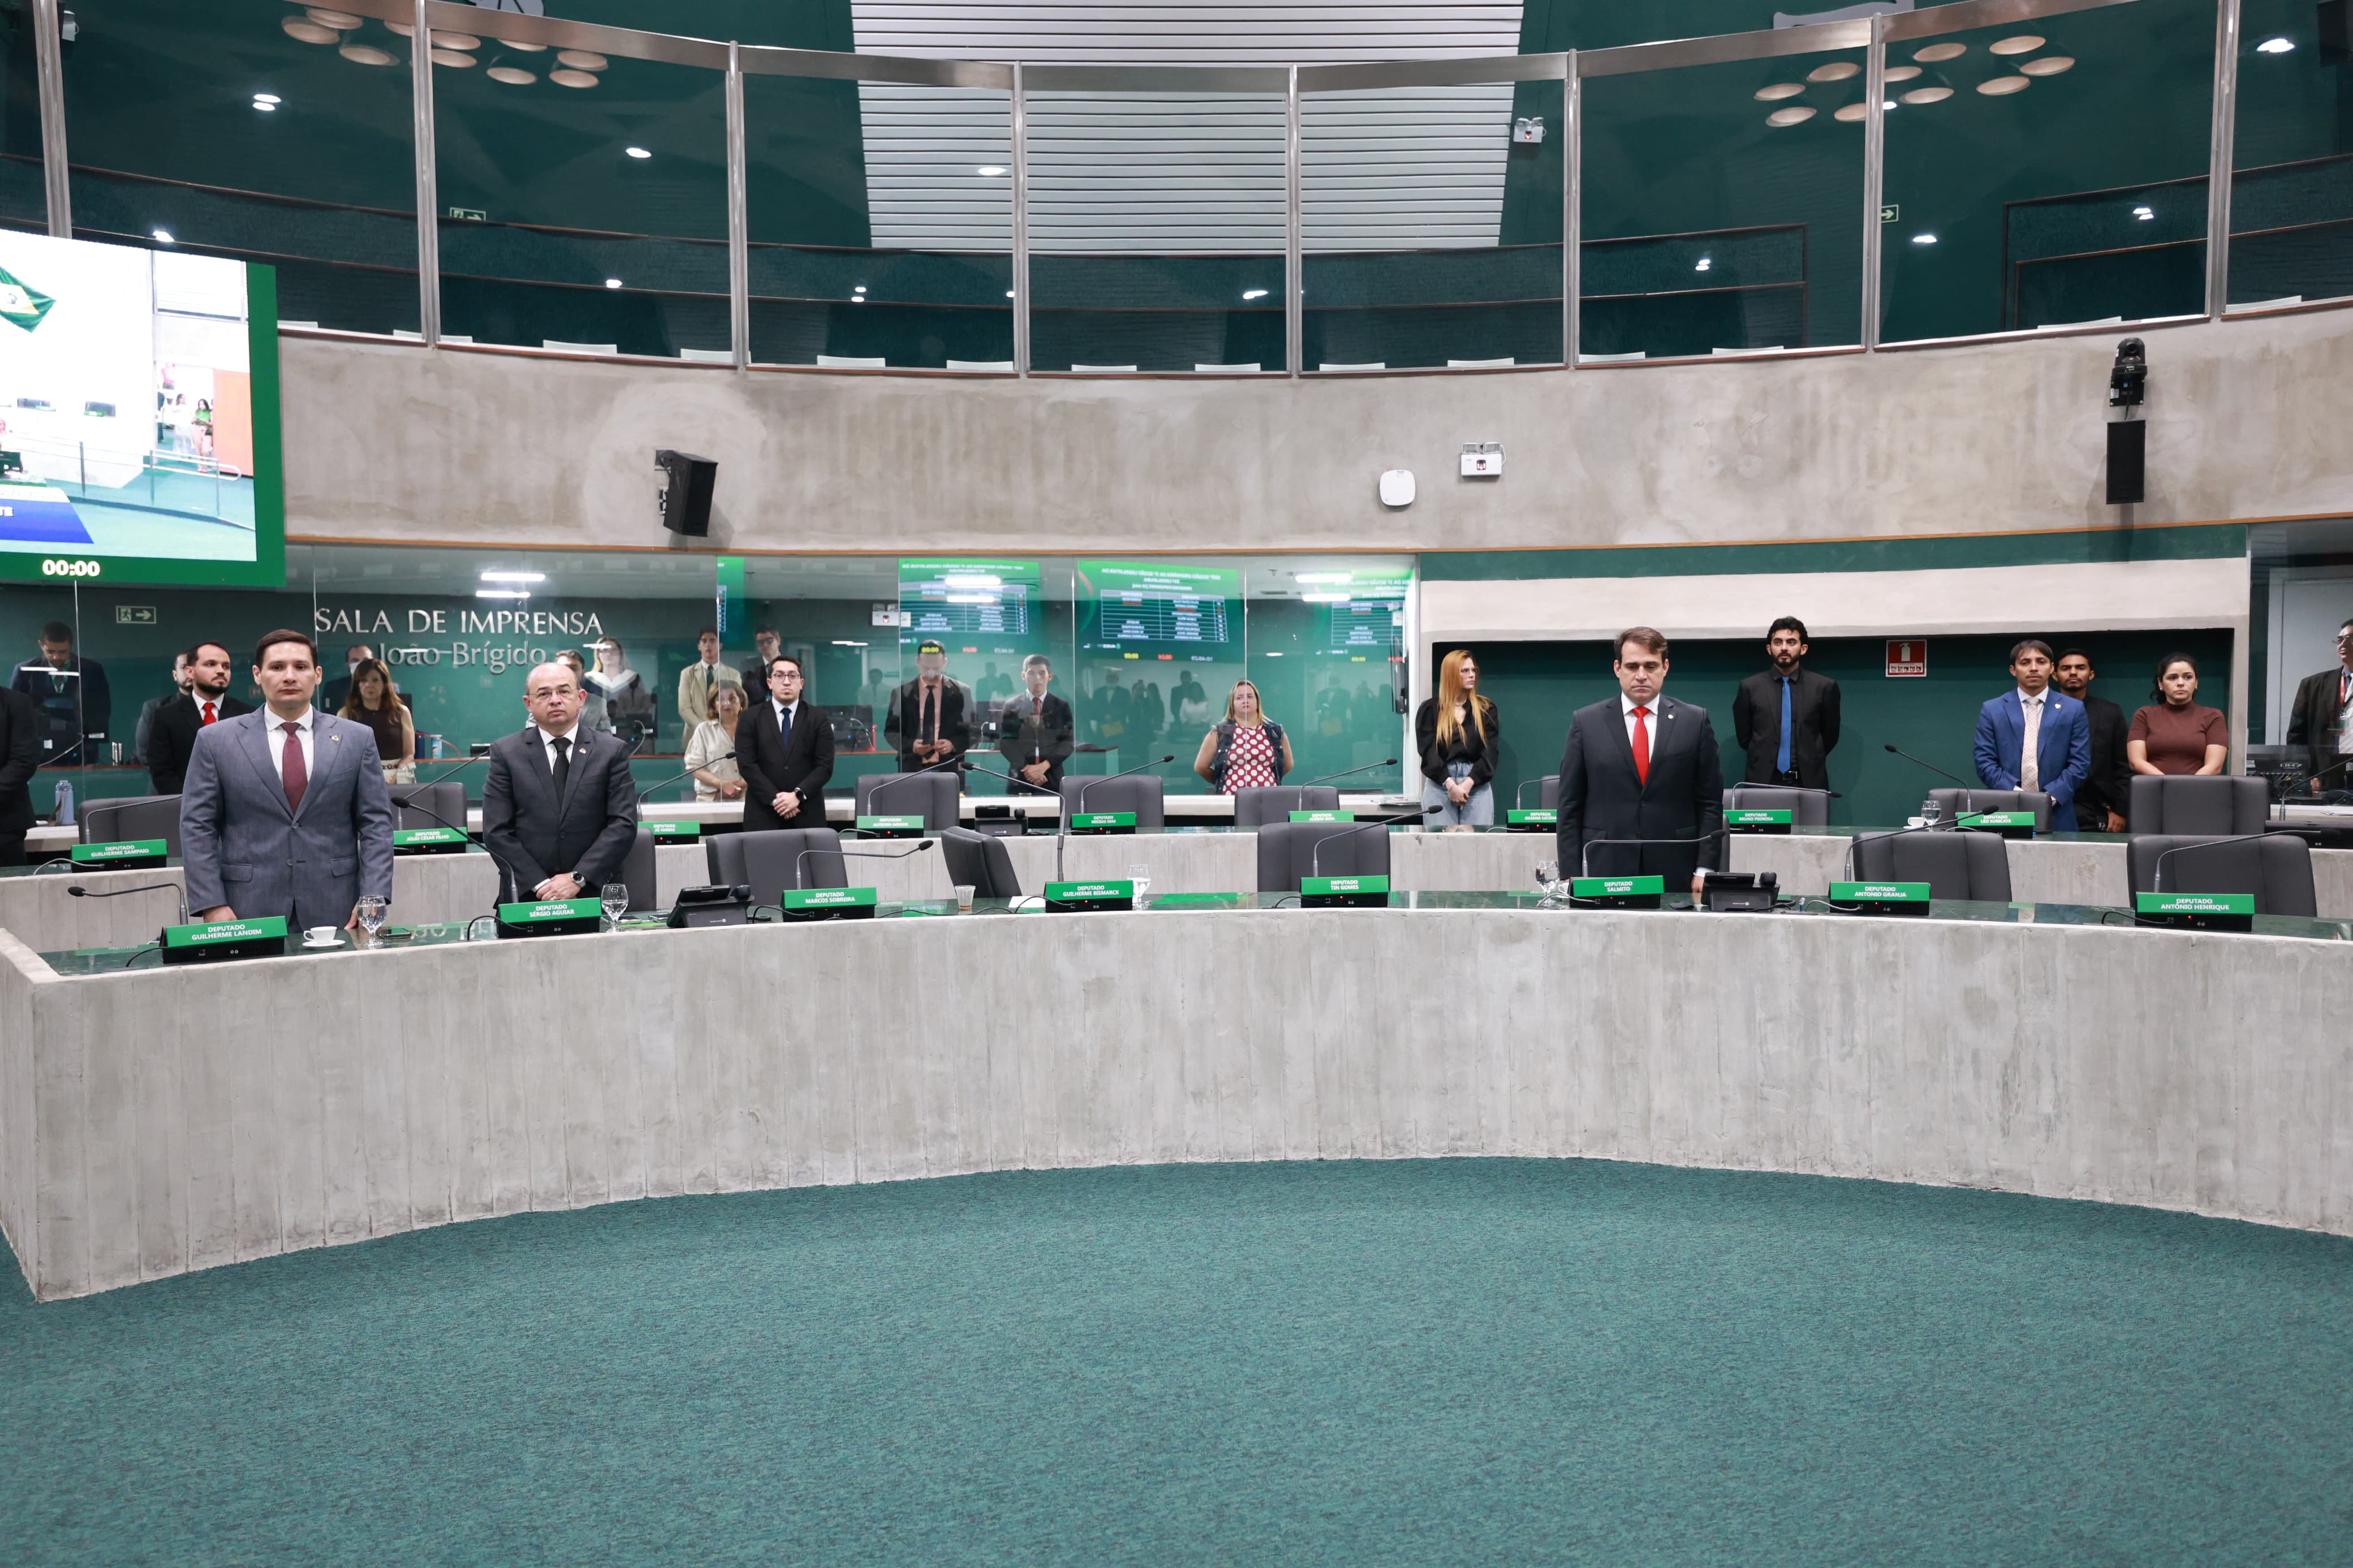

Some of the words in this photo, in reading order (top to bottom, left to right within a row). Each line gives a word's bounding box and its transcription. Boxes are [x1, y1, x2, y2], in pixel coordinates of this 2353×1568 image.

[42, 559, 101, 577] 00:00
[316, 607, 394, 634] SALA
[408, 610, 447, 634] DE
[460, 610, 604, 635] IMPRENSA
[379, 642, 441, 666] João
[453, 640, 546, 675] Brígido
[192, 931, 232, 940] GUILHERME
[208, 924, 245, 932] DEPUTADO
